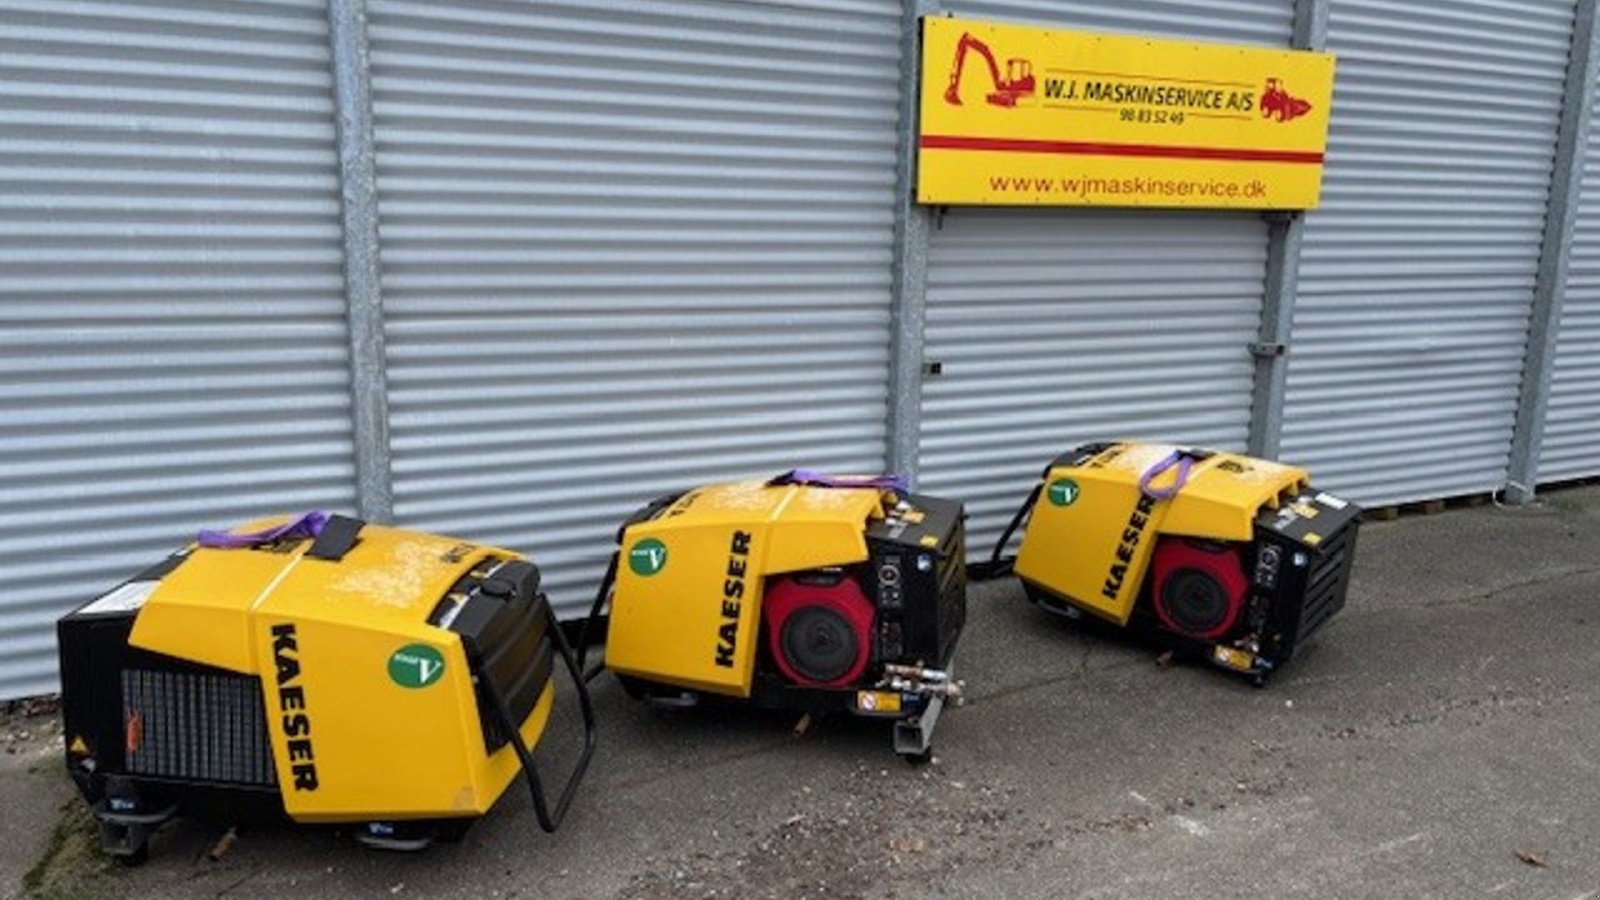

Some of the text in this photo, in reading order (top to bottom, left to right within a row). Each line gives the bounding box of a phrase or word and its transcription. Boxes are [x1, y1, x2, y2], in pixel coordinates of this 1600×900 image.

[1044, 78, 1254, 111] W.J. MASKINSERVICE A/S
[989, 174, 1267, 198] www.wjmaskinservice.dk
[715, 530, 751, 668] KAESER
[1101, 492, 1156, 600] KAESER
[270, 623, 319, 791] KAESER
